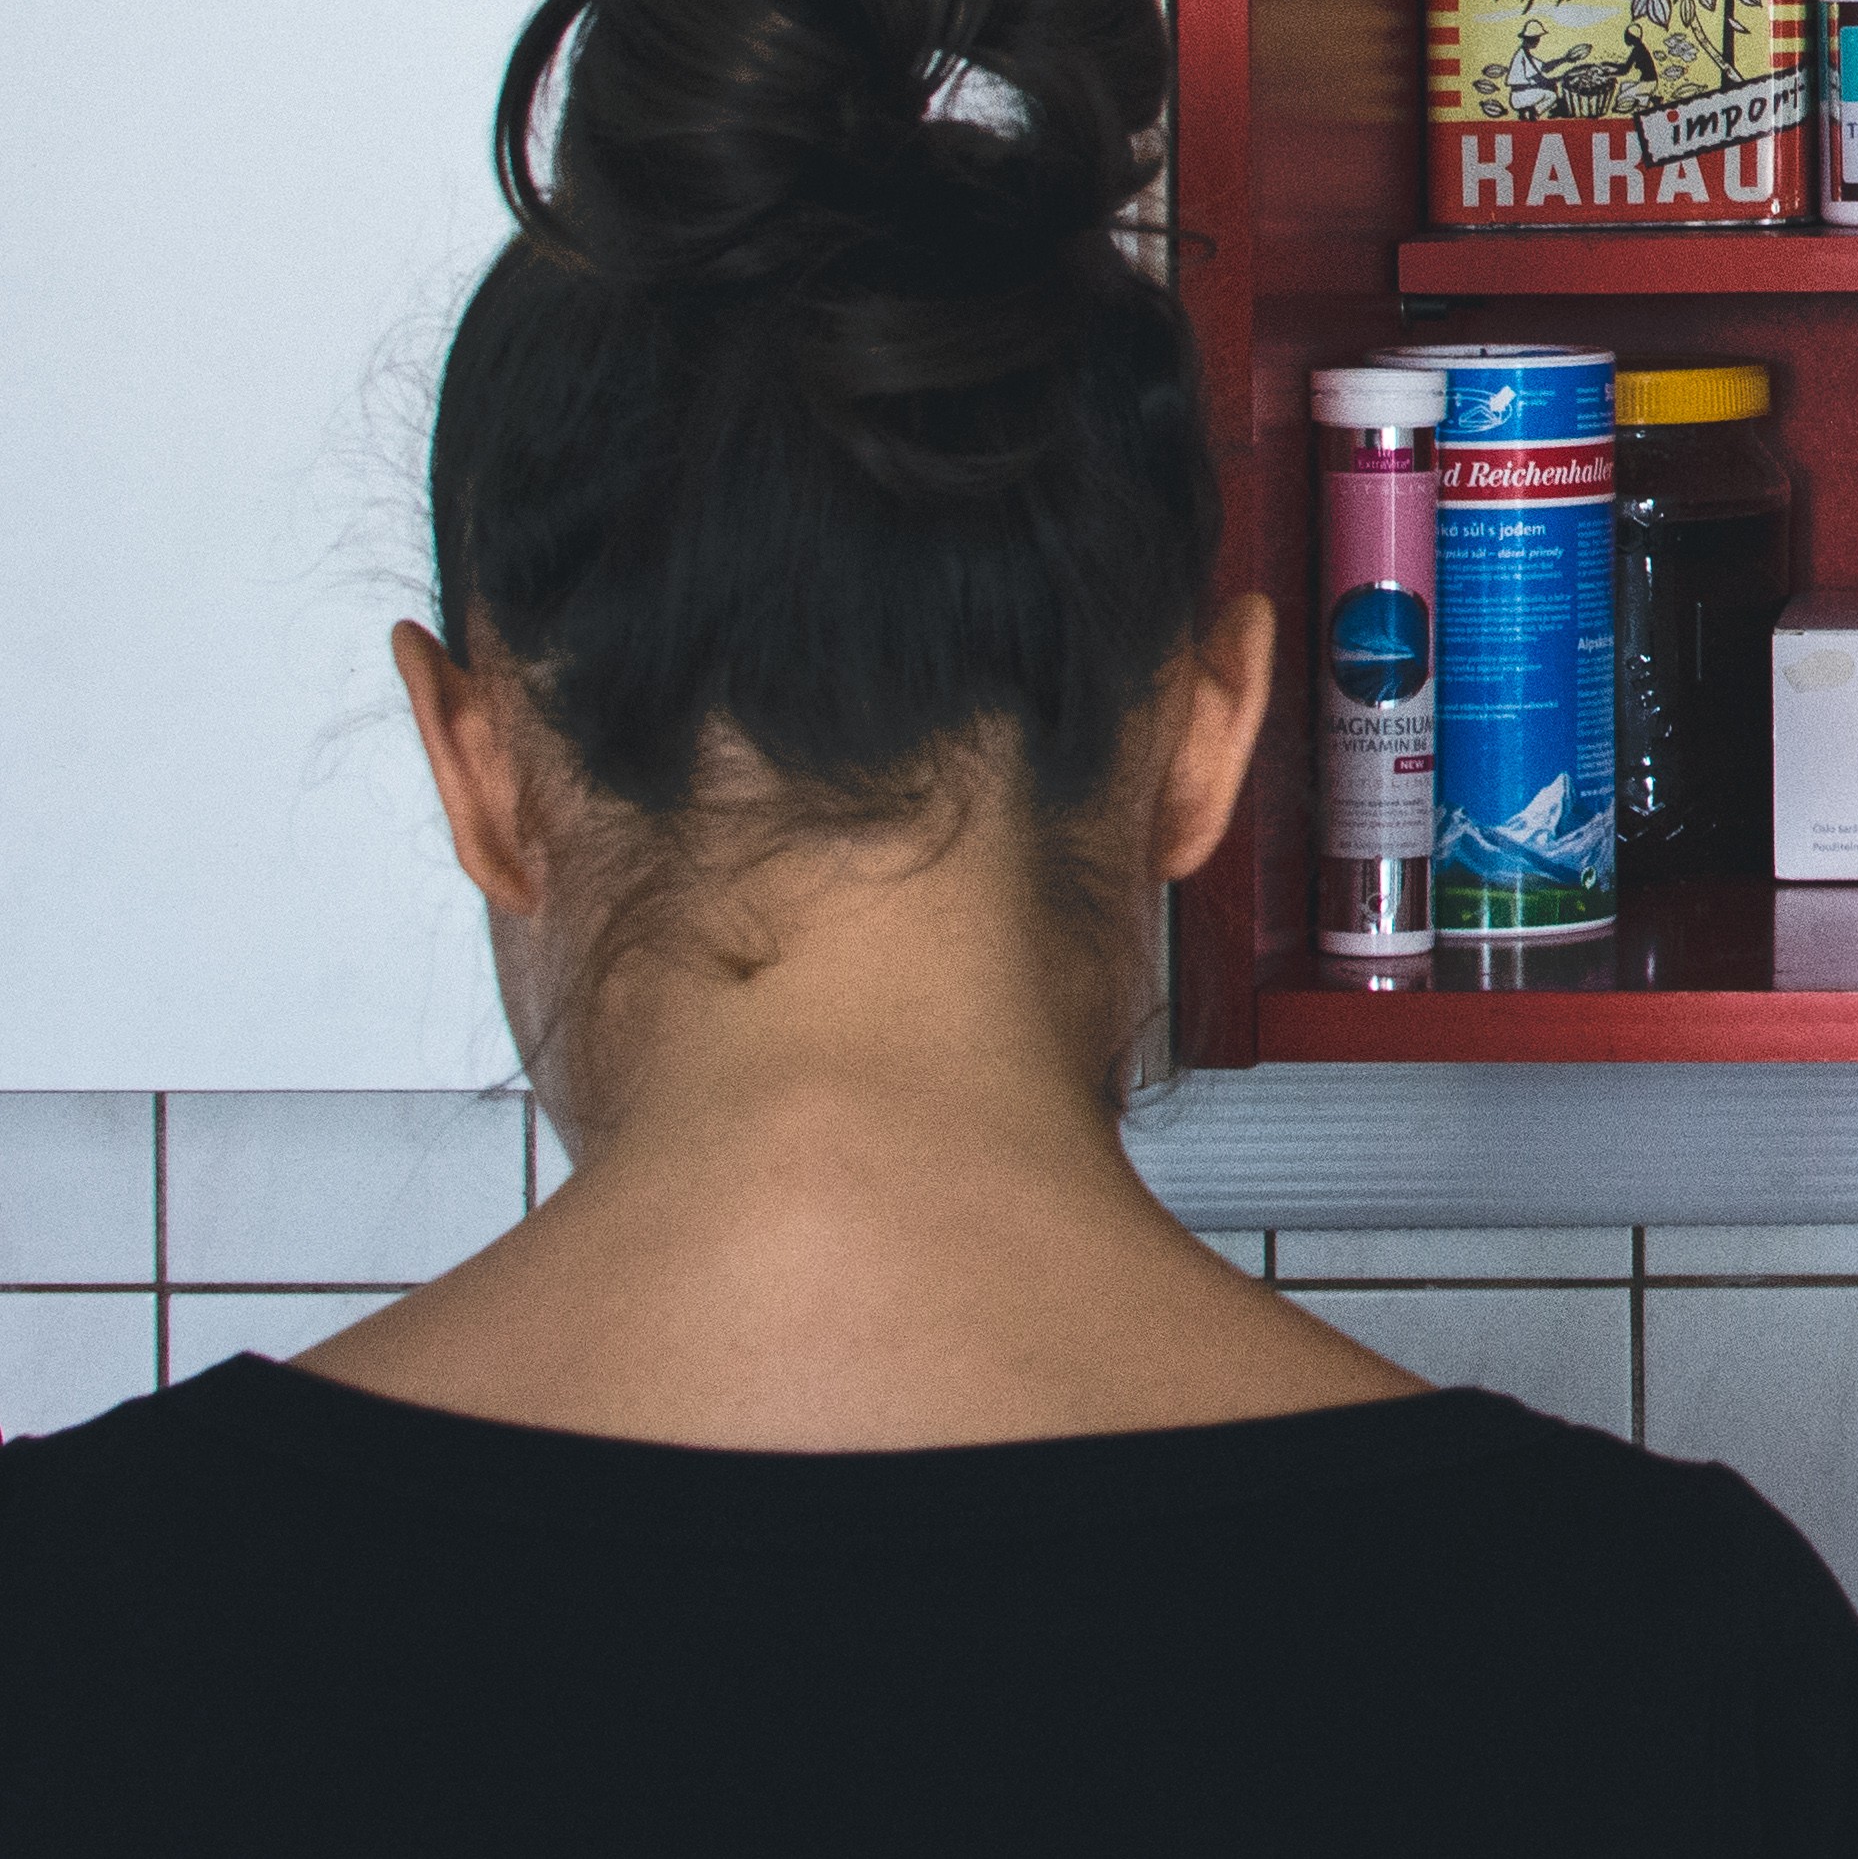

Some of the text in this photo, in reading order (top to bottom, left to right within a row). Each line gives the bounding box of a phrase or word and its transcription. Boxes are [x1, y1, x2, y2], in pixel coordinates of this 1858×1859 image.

[1667, 81, 1807, 147] import
[1460, 132, 1776, 209] KAKAO
[1467, 457, 1615, 489] Reichenhaller
[1498, 521, 1547, 541] jodem
[1399, 759, 1425, 771] NEW
